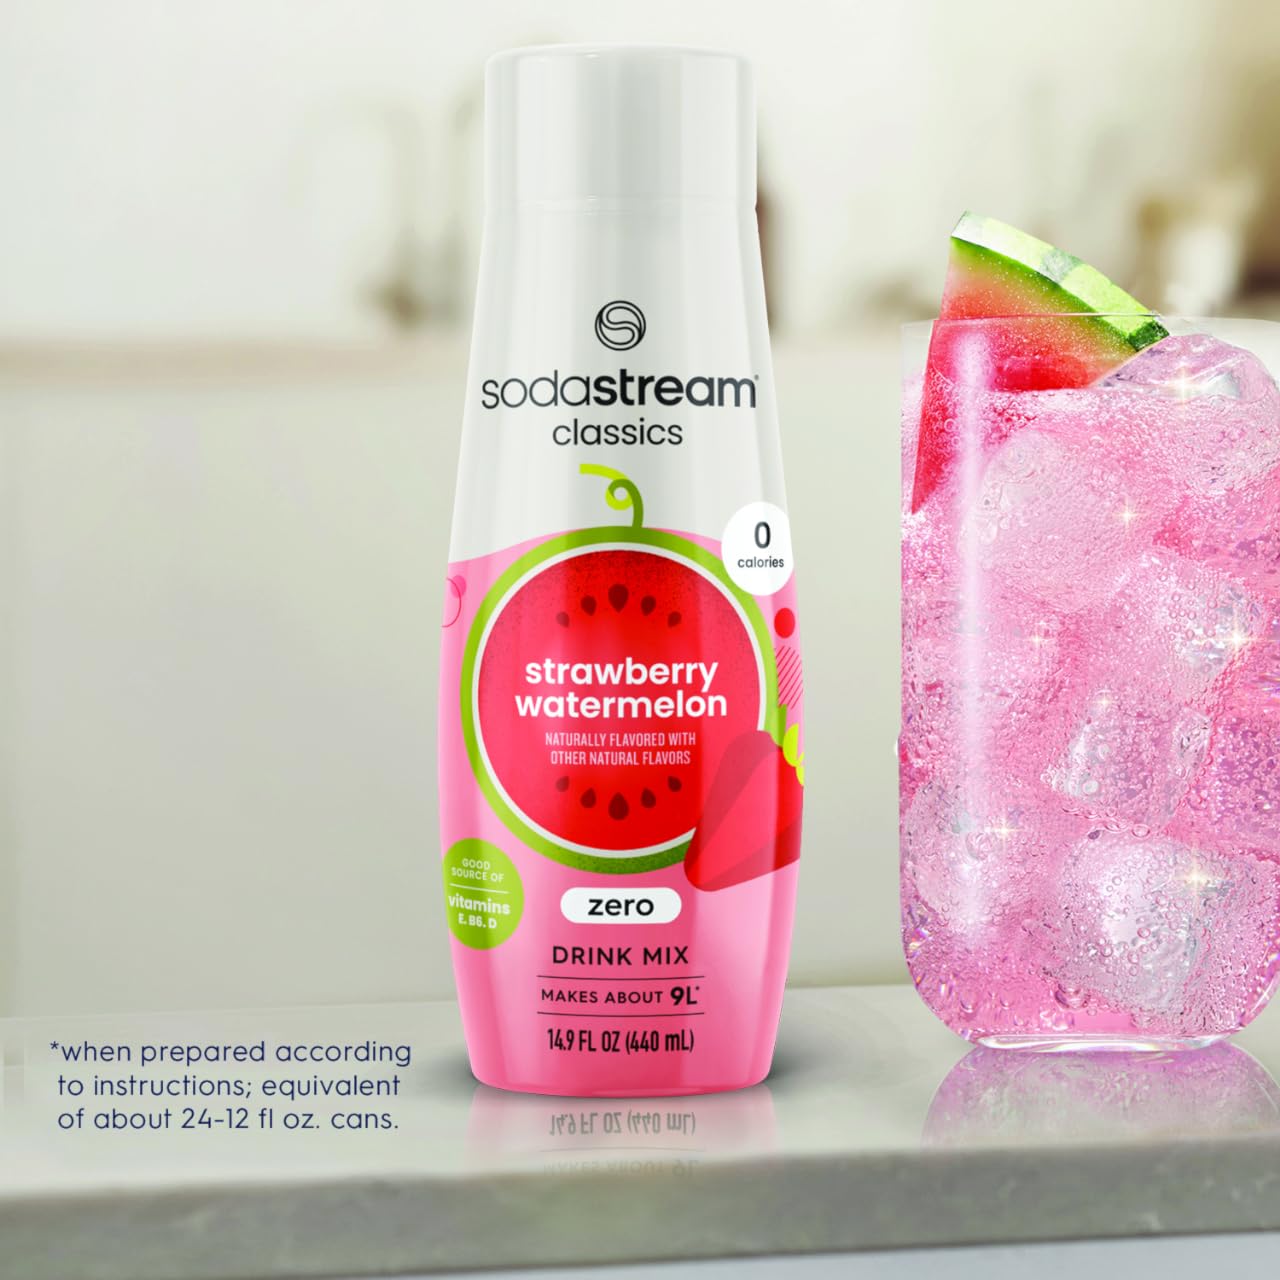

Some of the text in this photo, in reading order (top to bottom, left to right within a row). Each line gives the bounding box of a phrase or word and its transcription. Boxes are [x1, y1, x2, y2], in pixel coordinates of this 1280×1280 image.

[552, 417, 684, 446] classics
[754, 521, 771, 549] 0
[737, 556, 784, 568] calories
[525, 656, 719, 693] strawberry
[515, 689, 728, 718] watermelon
[545, 731, 696, 747] NATURALLY FLAVORED WITH
[550, 750, 690, 766] OTHER NATURAL FLAVORS
[461, 858, 491, 870] GOOD
[450, 867, 505, 883] SOURCE OF
[448, 893, 511, 914] vitamins
[587, 898, 655, 916] zero
[488, 918, 497, 929] D
[552, 946, 689, 965] DRINK MIX
[541, 989, 598, 1003] MAKES
[604, 991, 663, 1004] ABOUT
[547, 1028, 694, 1055] 14.9 FL OZ (440 mL)
